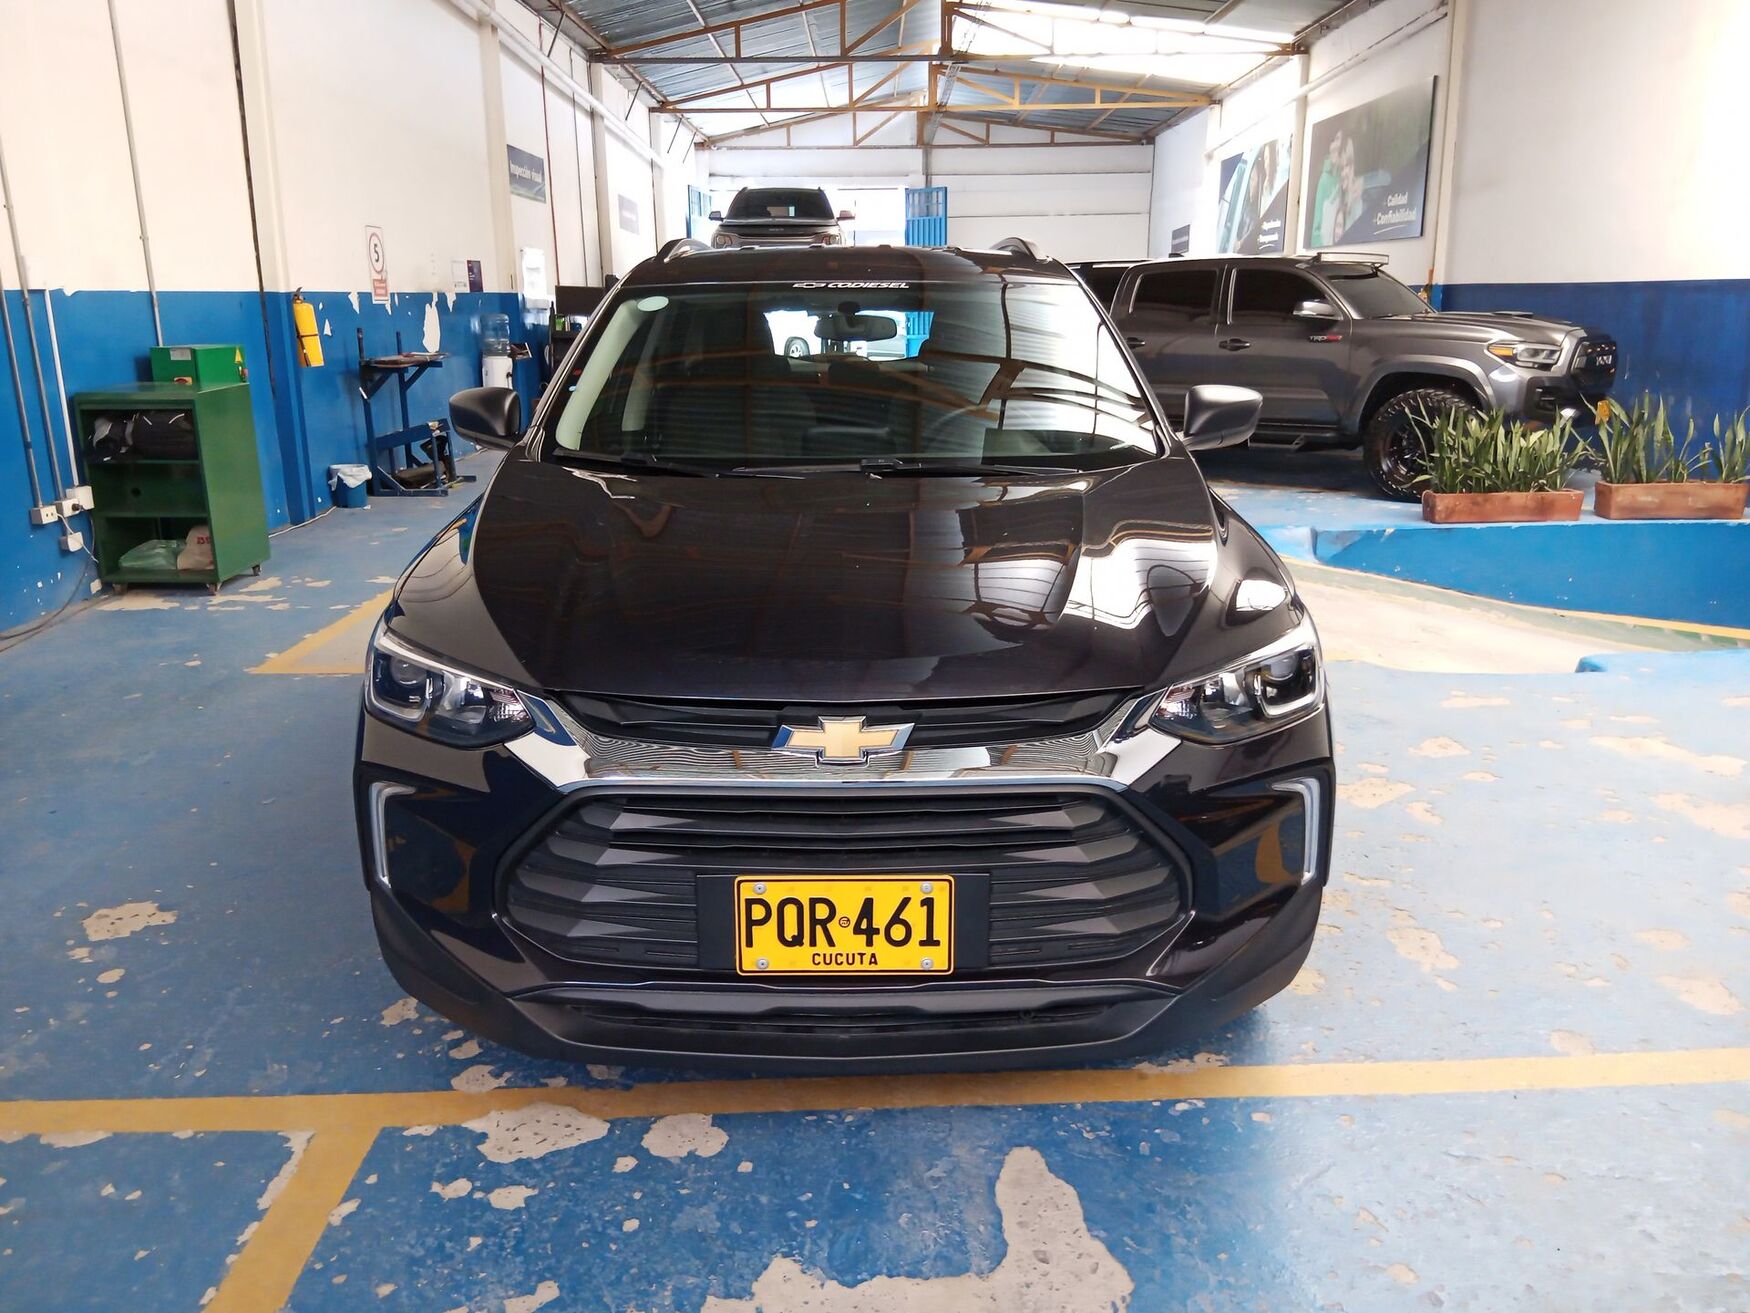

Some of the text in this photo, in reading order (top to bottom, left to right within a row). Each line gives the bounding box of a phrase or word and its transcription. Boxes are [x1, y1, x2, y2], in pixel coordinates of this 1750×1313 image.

[373, 243, 380, 263] 5
[744, 896, 941, 948] PQR 461
[812, 952, 878, 966] CUCUTA
